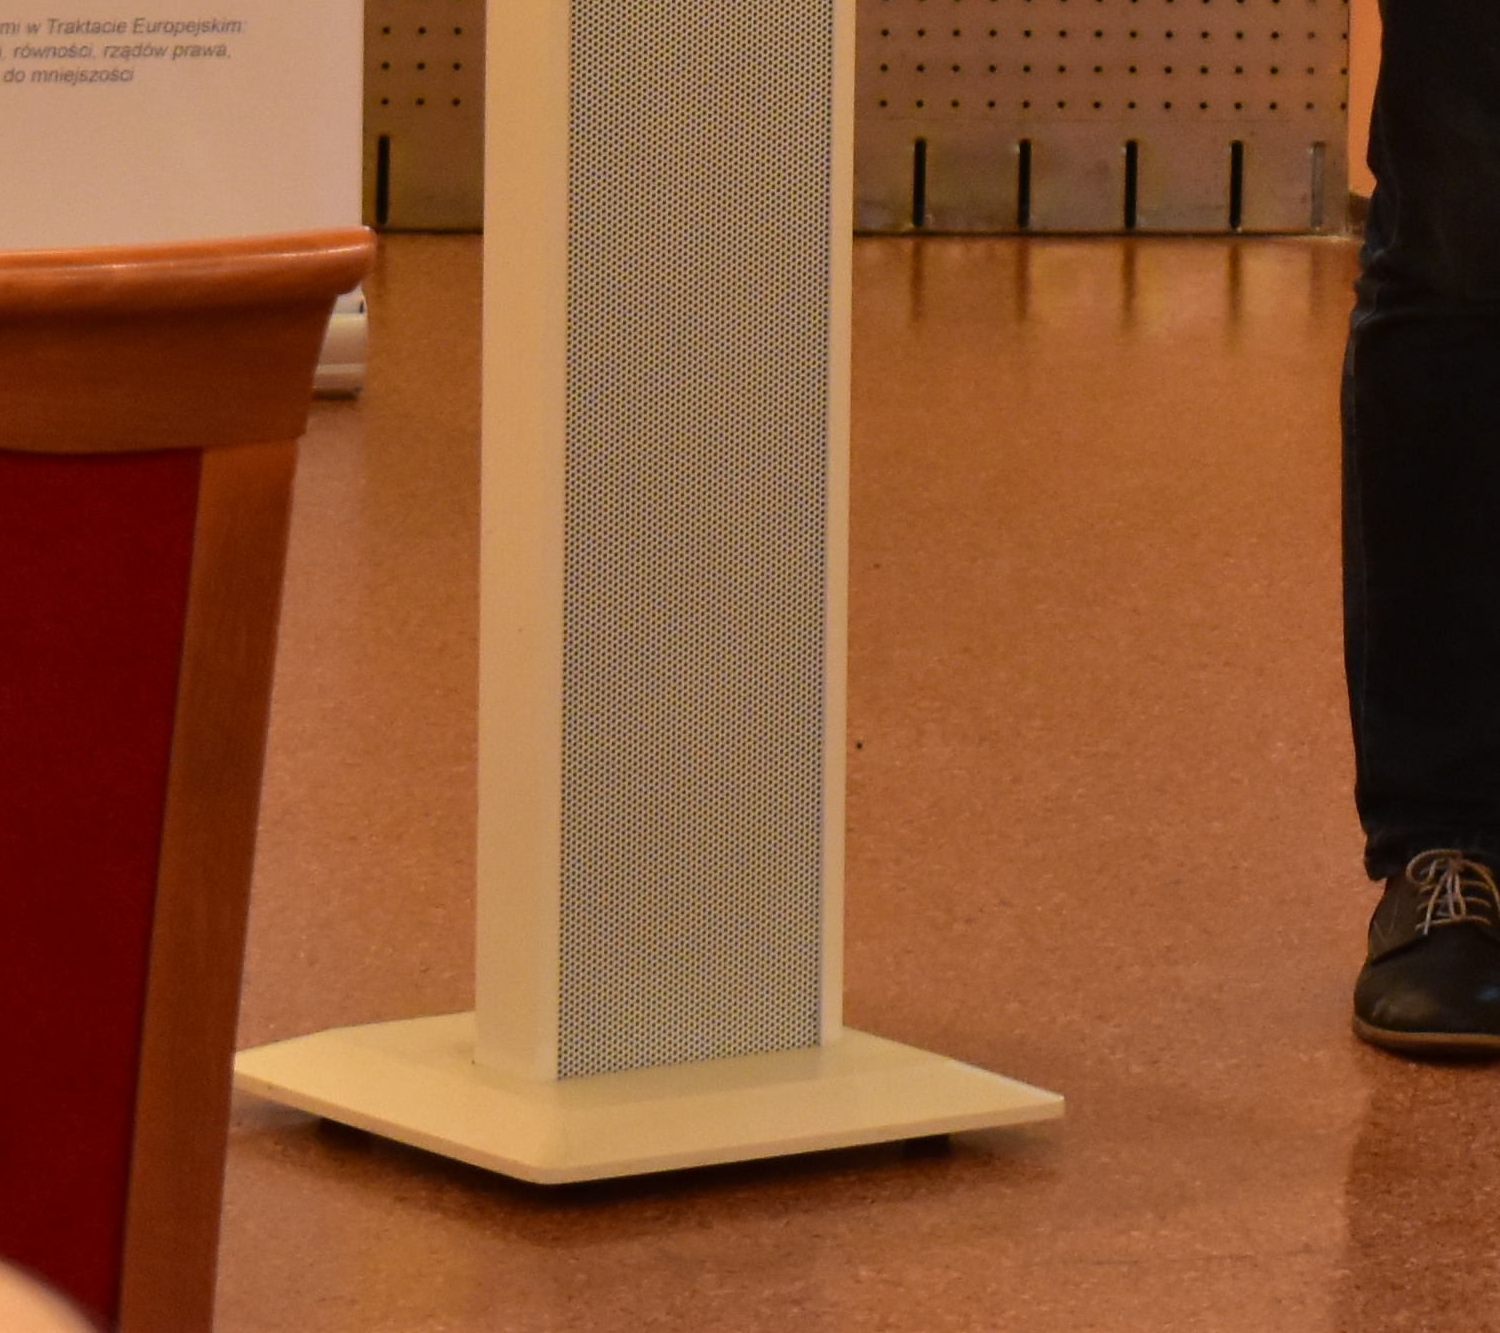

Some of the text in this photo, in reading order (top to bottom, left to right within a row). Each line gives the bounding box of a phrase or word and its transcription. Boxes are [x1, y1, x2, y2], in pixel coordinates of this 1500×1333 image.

[26, 23, 40, 35] w
[47, 19, 126, 35] Traktacie
[104, 42, 166, 62] rządów
[3, 68, 25, 83] do
[31, 67, 135, 86] mniejszości
